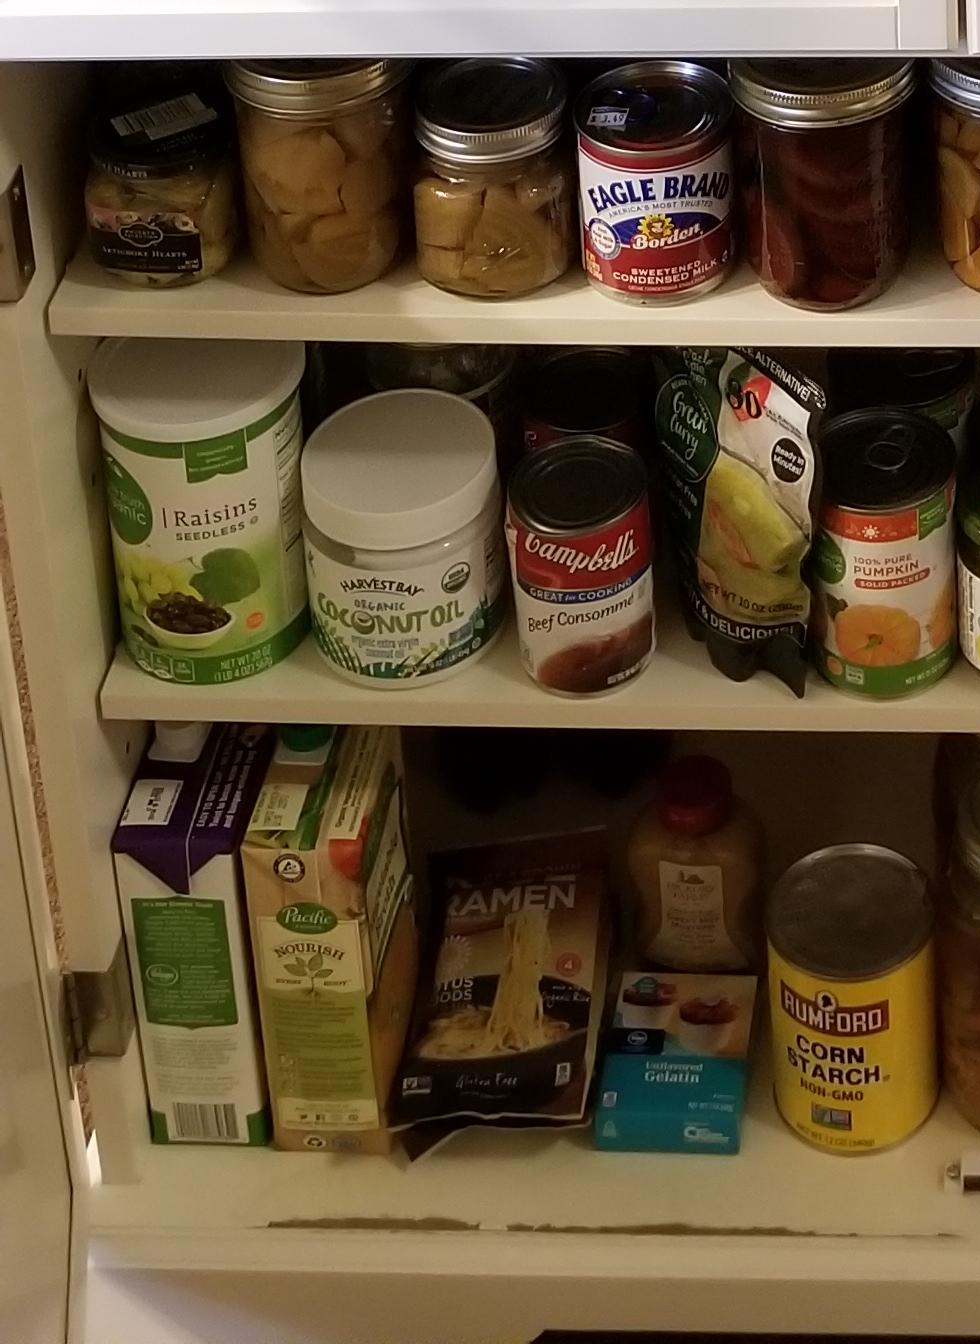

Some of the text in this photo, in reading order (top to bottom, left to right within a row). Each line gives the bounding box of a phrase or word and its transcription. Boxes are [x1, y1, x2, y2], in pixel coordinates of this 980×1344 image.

[587, 171, 730, 213] EAGLE BRAND
[652, 200, 713, 210] MOST TRUSTED
[633, 222, 701, 250] Borden
[612, 272, 690, 284] CONDENSED
[693, 258, 717, 276] MILK
[631, 260, 701, 275] SWEETENED
[755, 351, 811, 402] ALTERNATIVE!
[174, 497, 258, 527] Raisins
[175, 521, 246, 541] SEEDLESS
[524, 529, 639, 574] Campbell's
[853, 553, 913, 565] 100% PURE
[853, 559, 919, 578] PUMPKIN
[340, 577, 423, 596] HARVEST BAY
[530, 578, 633, 603] GREAT COOKING
[860, 579, 889, 589] SOLID
[317, 592, 465, 637] COCONUT OIL
[528, 593, 635, 633] Beef Consommé
[280, 906, 333, 928] Pacific
[272, 941, 346, 961] NOURISH
[783, 987, 883, 1032] RUMFORD
[796, 1035, 865, 1064] CORN
[644, 1070, 700, 1084] Gelatin
[787, 1047, 881, 1085] STARCH
[800, 1077, 864, 1102] NON-GMO
